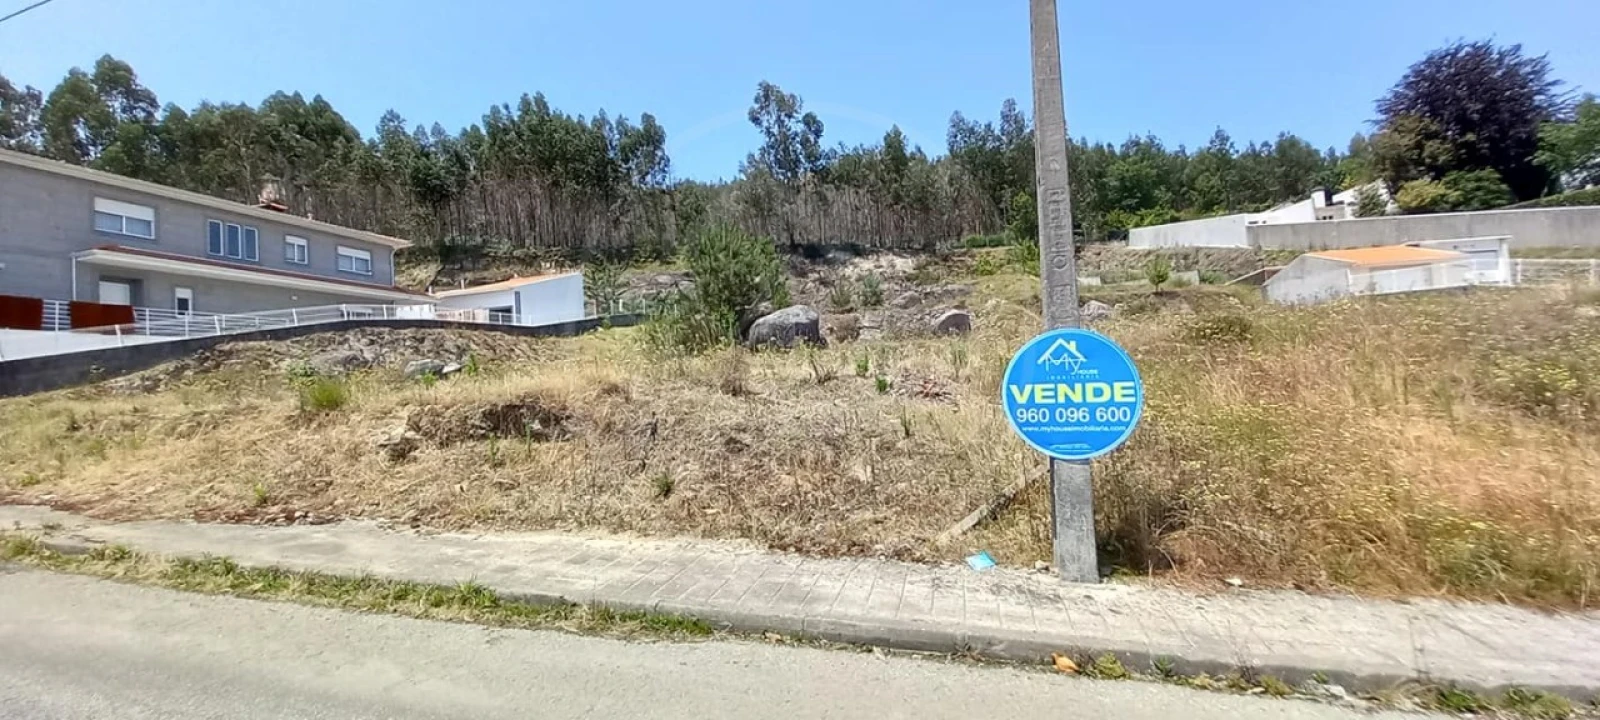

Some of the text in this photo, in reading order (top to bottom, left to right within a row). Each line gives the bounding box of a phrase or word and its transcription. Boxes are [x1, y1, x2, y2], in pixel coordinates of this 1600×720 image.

[1009, 382, 1136, 404] VENDE
[1016, 406, 1131, 423] 960 096 600
